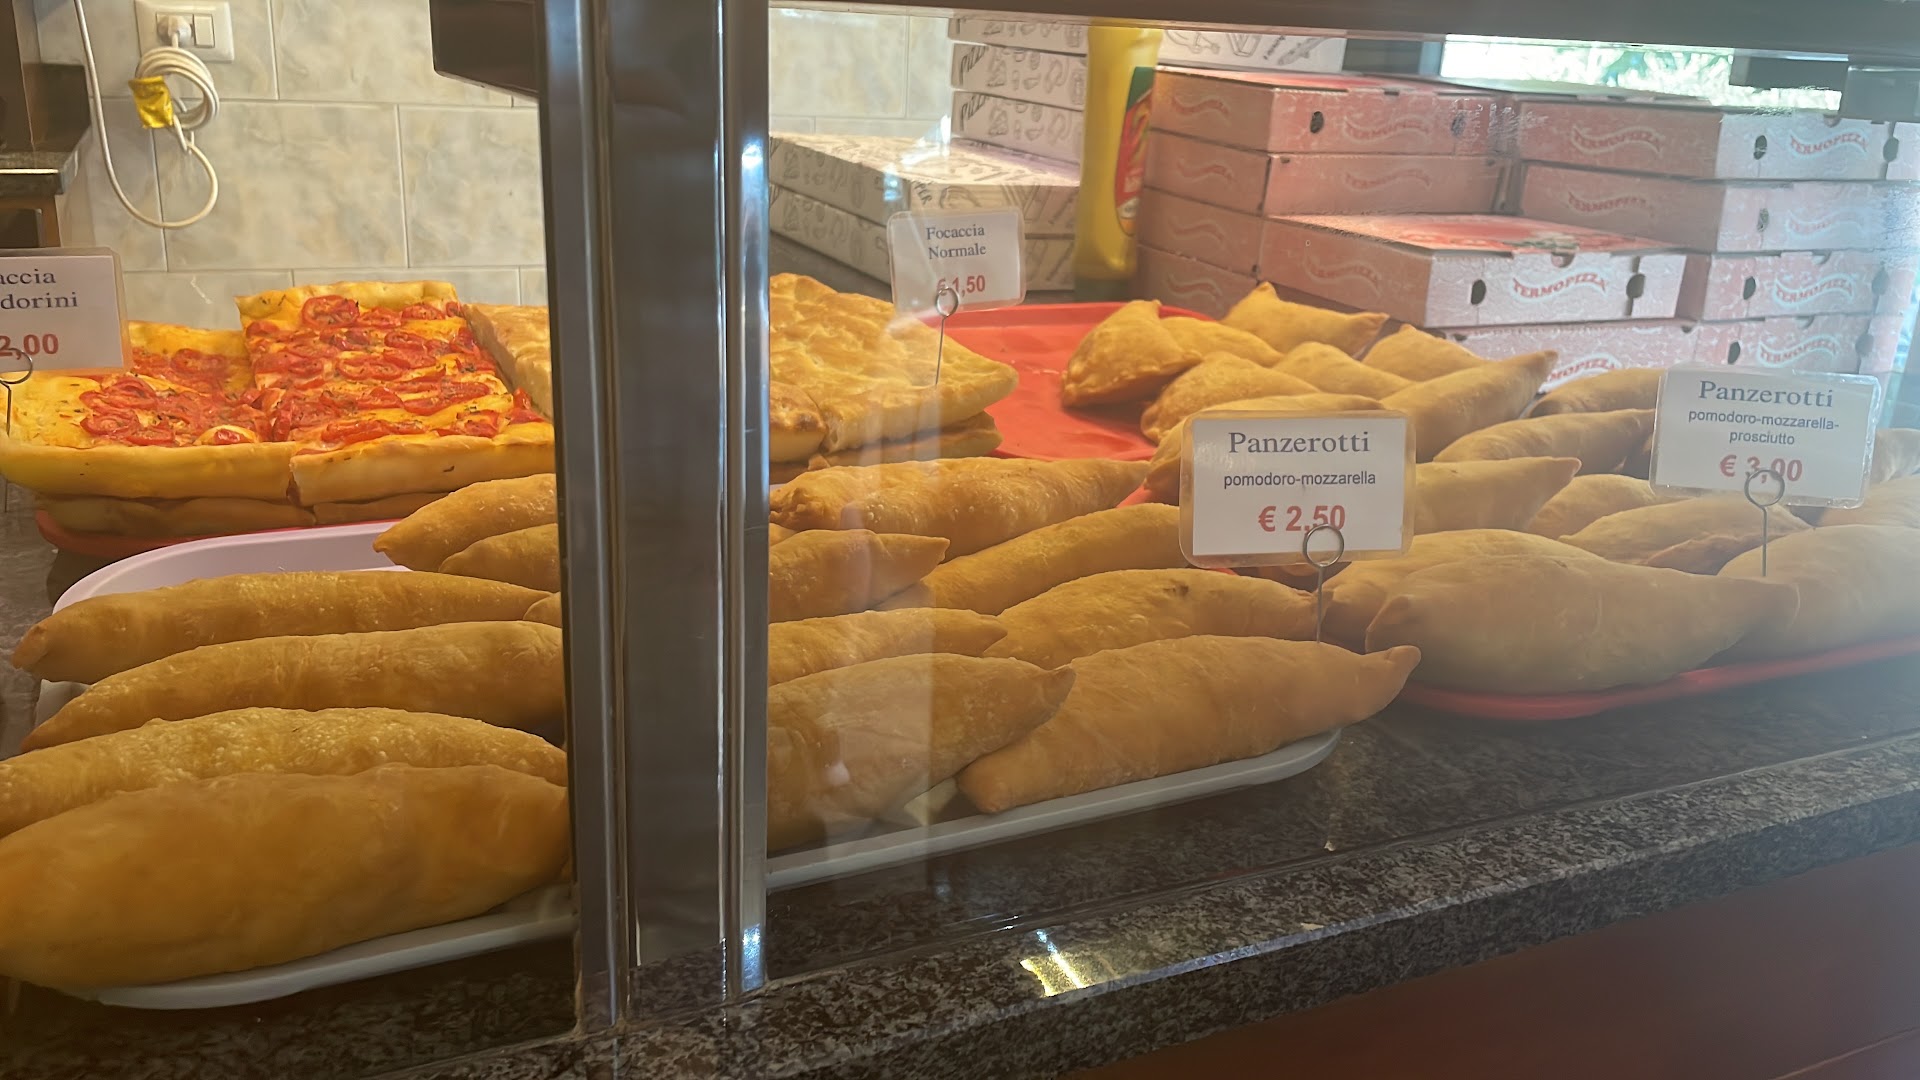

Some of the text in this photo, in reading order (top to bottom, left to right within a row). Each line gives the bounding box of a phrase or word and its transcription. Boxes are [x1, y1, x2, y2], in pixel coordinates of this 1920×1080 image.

[1789, 132, 1868, 155] TERMOPIZZA
[926, 224, 985, 240] Focaccia
[928, 243, 987, 260] Normale
[952, 275, 985, 297] 1,50
[1512, 271, 1606, 298] TERMOPIZZA
[0, 291, 78, 310] dorini
[1697, 380, 1833, 408] Panzerotti
[1688, 410, 1839, 431] pomodoro-mozzarella-
[1228, 431, 1371, 454] Panzerotti
[1729, 430, 1795, 446] prosciutto
[1719, 454, 1803, 484] € 3,00
[1223, 471, 1376, 490] pomodoro-mozzarella
[1257, 504, 1346, 536] € 2,50
